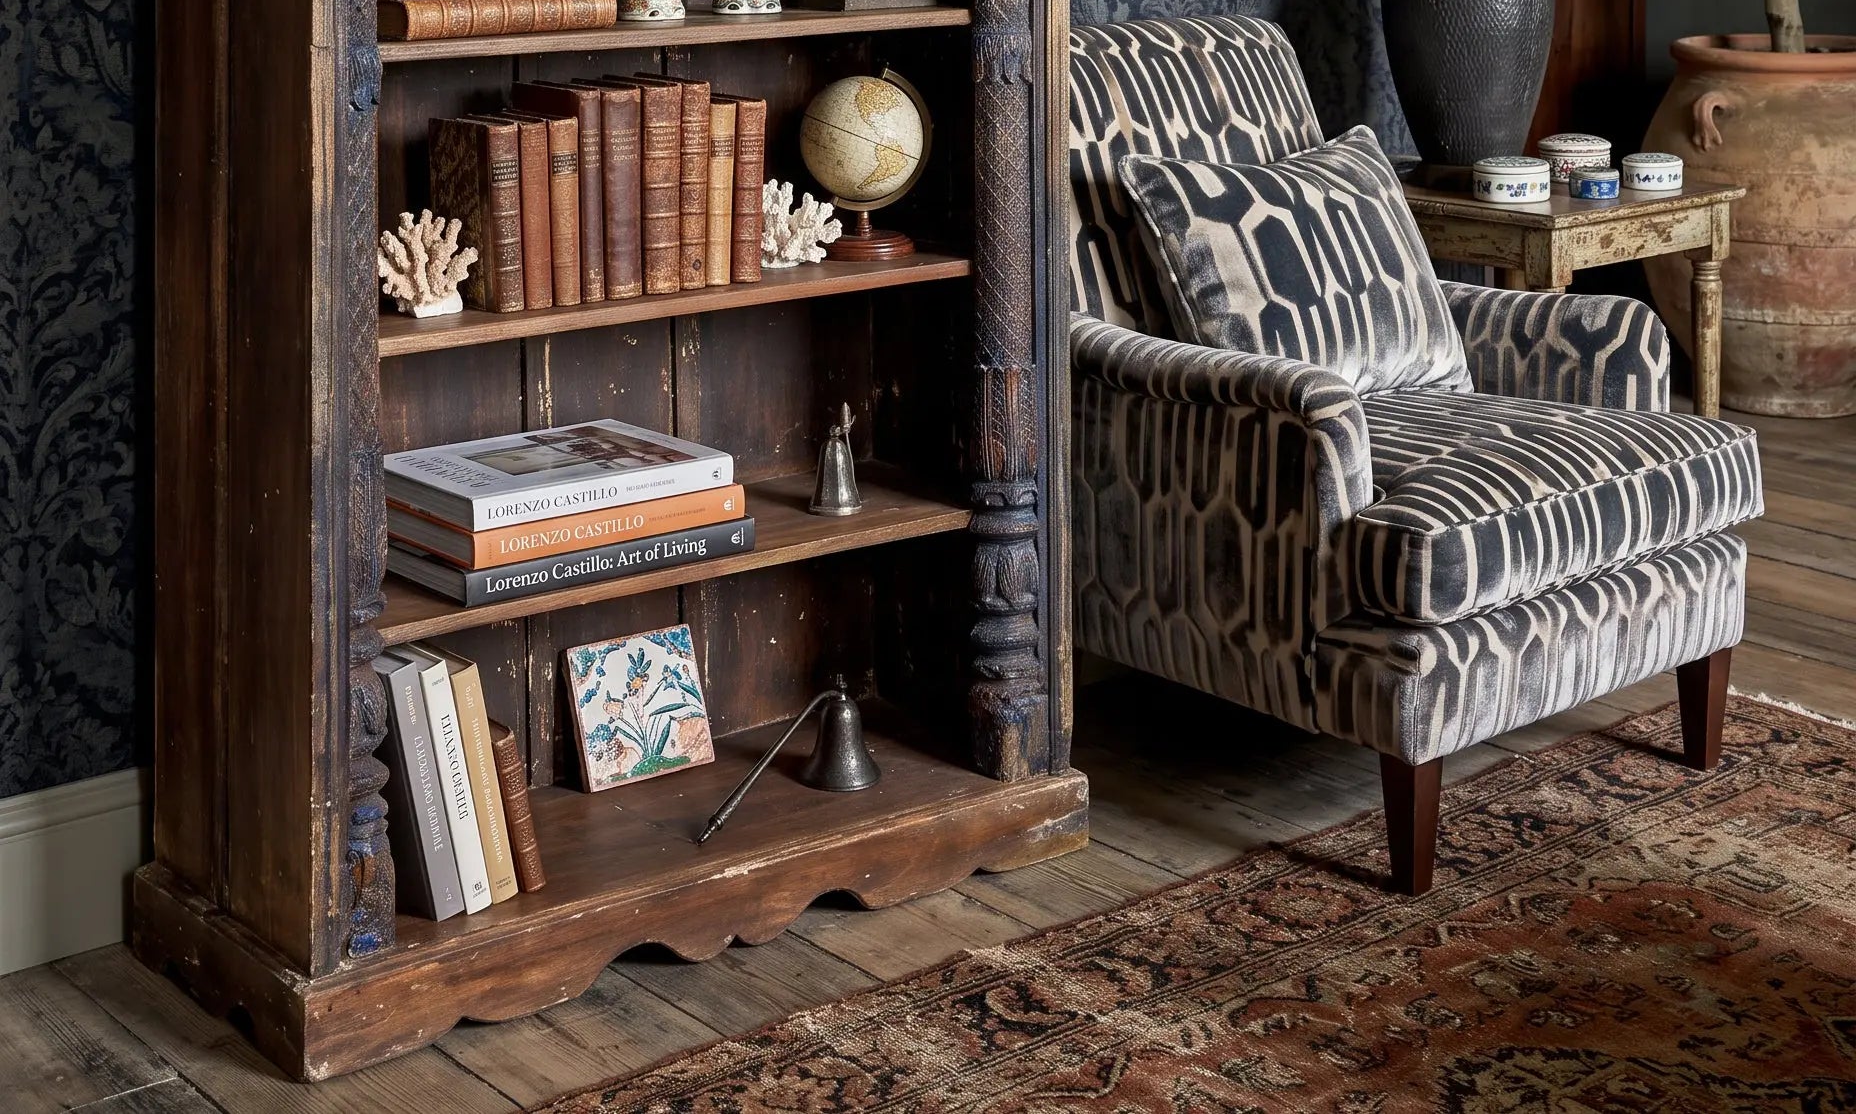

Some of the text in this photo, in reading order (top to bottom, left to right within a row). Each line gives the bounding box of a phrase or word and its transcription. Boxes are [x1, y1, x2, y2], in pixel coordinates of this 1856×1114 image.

[488, 486, 618, 520] LORENZO CASTILLO
[500, 515, 644, 554] LORENZO CASTILLO
[486, 538, 707, 594] Lorenzo Castillo: Art of Living
